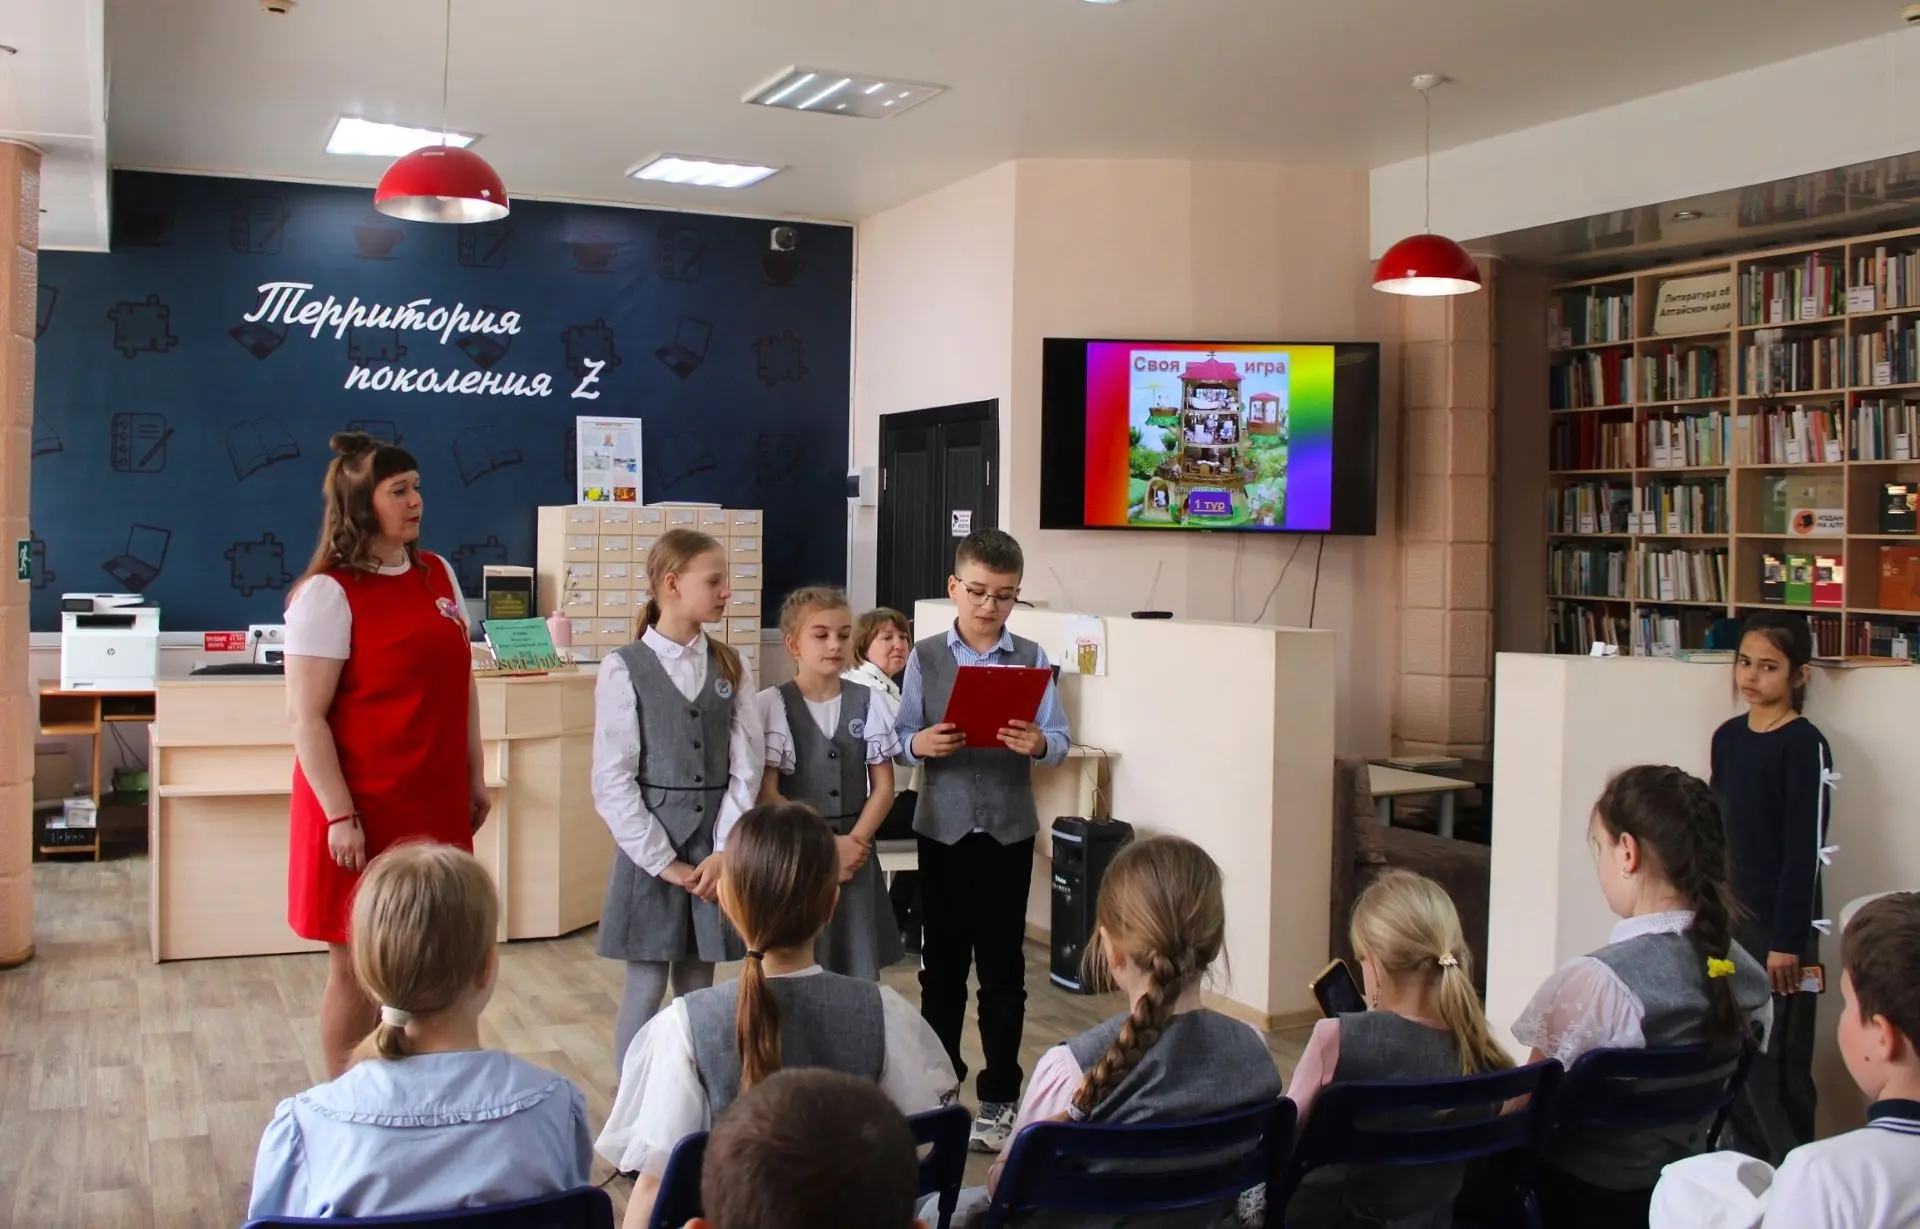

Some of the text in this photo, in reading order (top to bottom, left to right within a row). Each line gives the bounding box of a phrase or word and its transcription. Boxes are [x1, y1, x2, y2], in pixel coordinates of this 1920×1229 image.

[243, 281, 521, 345] Территория
[343, 357, 606, 400] поколения Z
[1133, 355, 1286, 377] Своя игра
[1194, 499, 1226, 512] 1 тур
